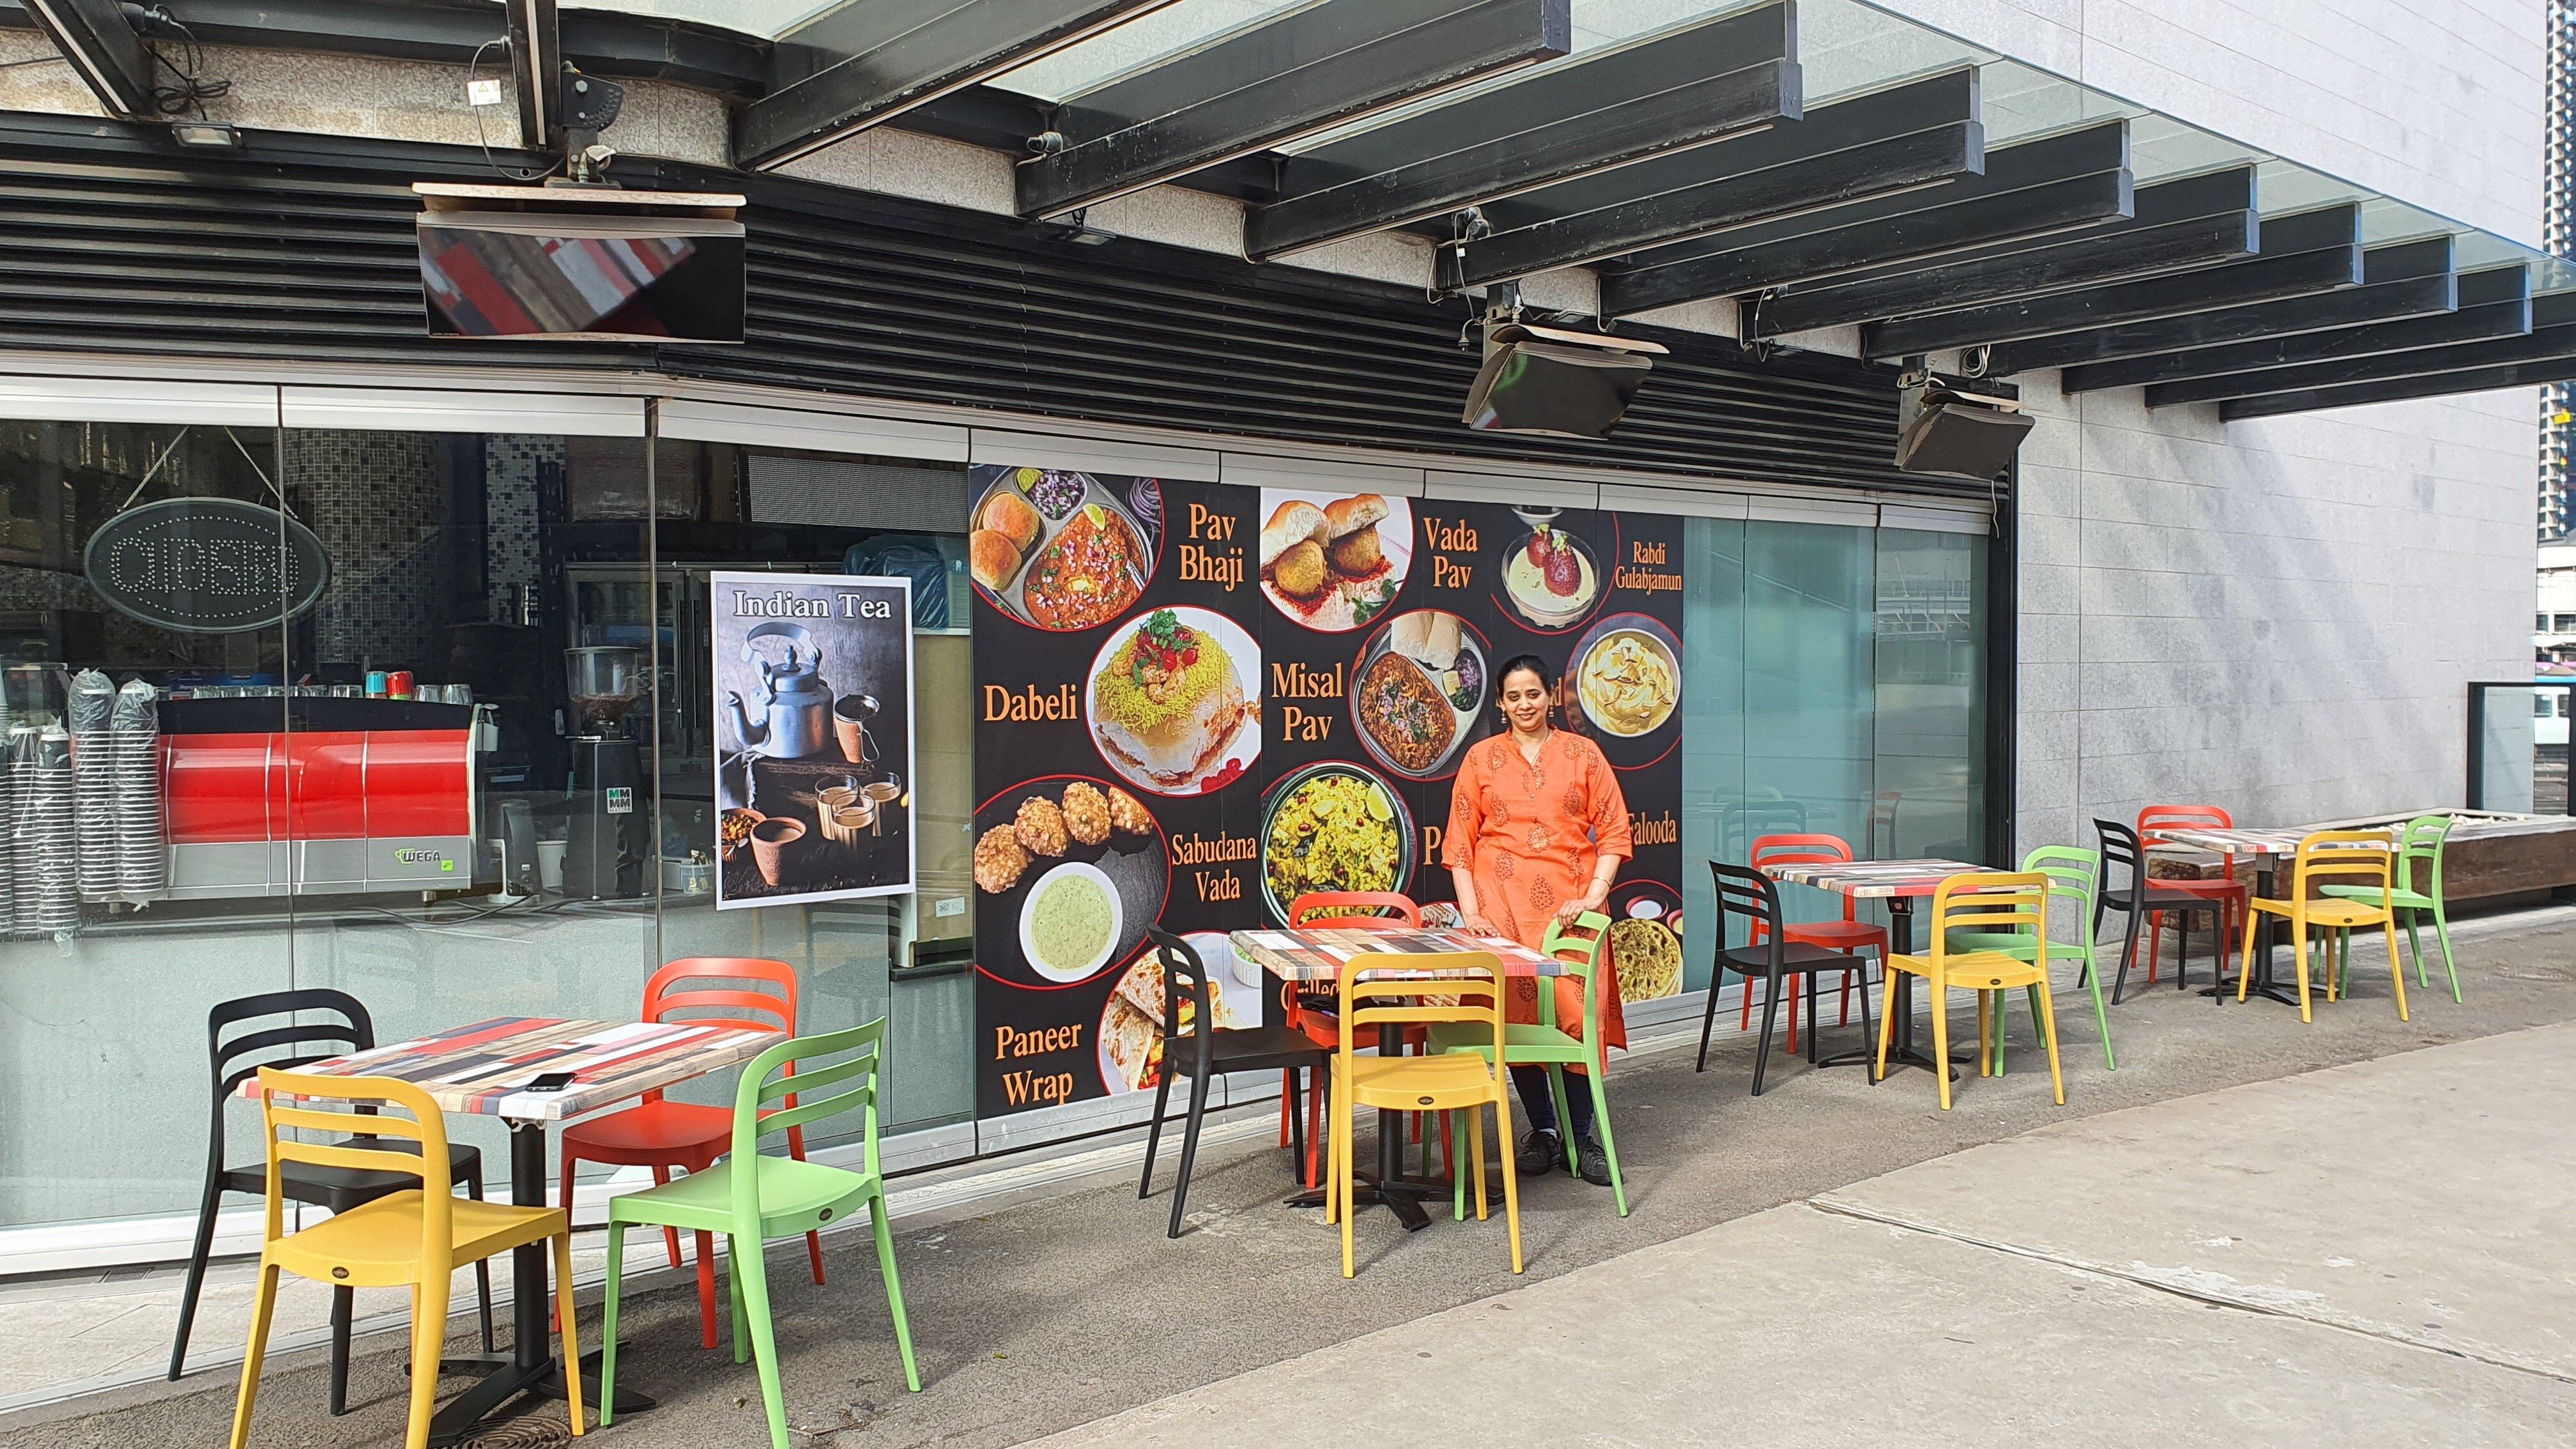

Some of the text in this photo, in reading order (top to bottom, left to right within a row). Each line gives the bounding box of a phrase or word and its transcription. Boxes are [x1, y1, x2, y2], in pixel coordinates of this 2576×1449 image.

[1188, 503, 1236, 541] Pav
[1423, 518, 1478, 552] Vada
[1179, 545, 1244, 592] Bhaji
[1633, 541, 1666, 565] Rabdi
[1434, 556, 1472, 588] Pav
[1615, 565, 1682, 595] Gulabjamun
[733, 590, 892, 619] Indian Tea
[1271, 662, 1343, 698] Misal
[983, 684, 1078, 721] Dabeli
[1283, 707, 1333, 741] Pav
[402, 850, 441, 862] WEGA
[1172, 831, 1257, 866] Sabudana
[1195, 869, 1241, 902] Vada
[995, 1023, 1082, 1060] Paneer
[1002, 1070, 1073, 1107] Wrap
